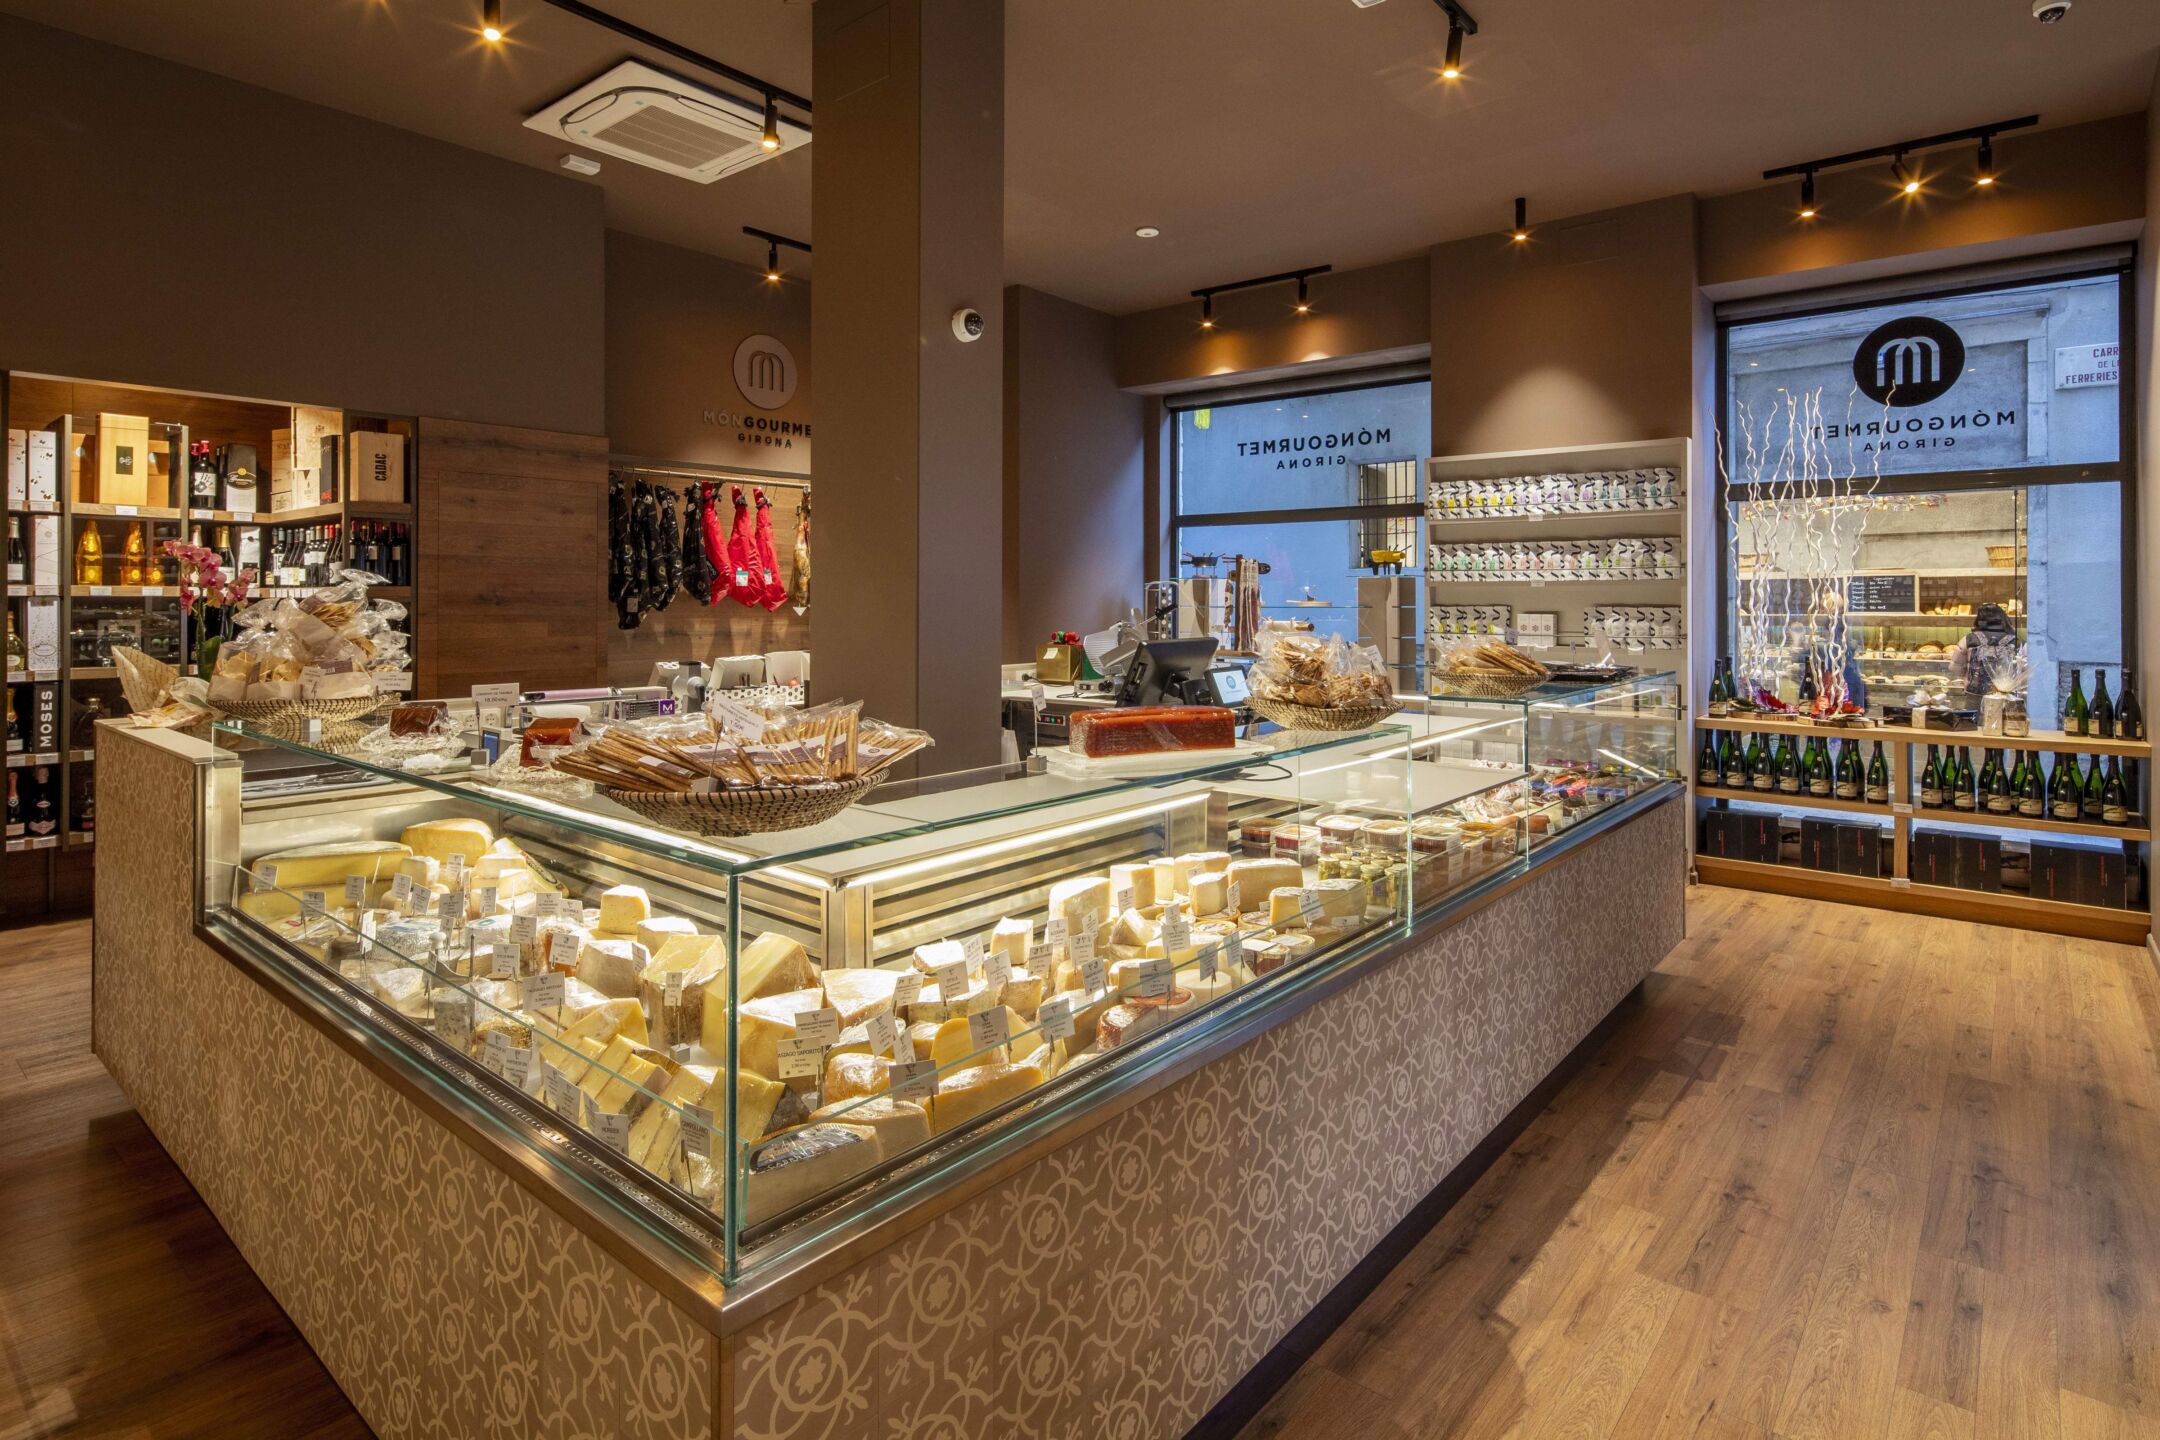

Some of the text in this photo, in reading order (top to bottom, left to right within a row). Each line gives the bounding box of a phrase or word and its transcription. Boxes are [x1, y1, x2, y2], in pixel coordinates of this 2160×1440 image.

[2097, 360, 2108, 368] DE
[2065, 370, 2118, 384] FERRERIES
[738, 433, 792, 449] GIRONA
[374, 453, 387, 481] CADAC
[40, 690, 53, 748] MOSES
